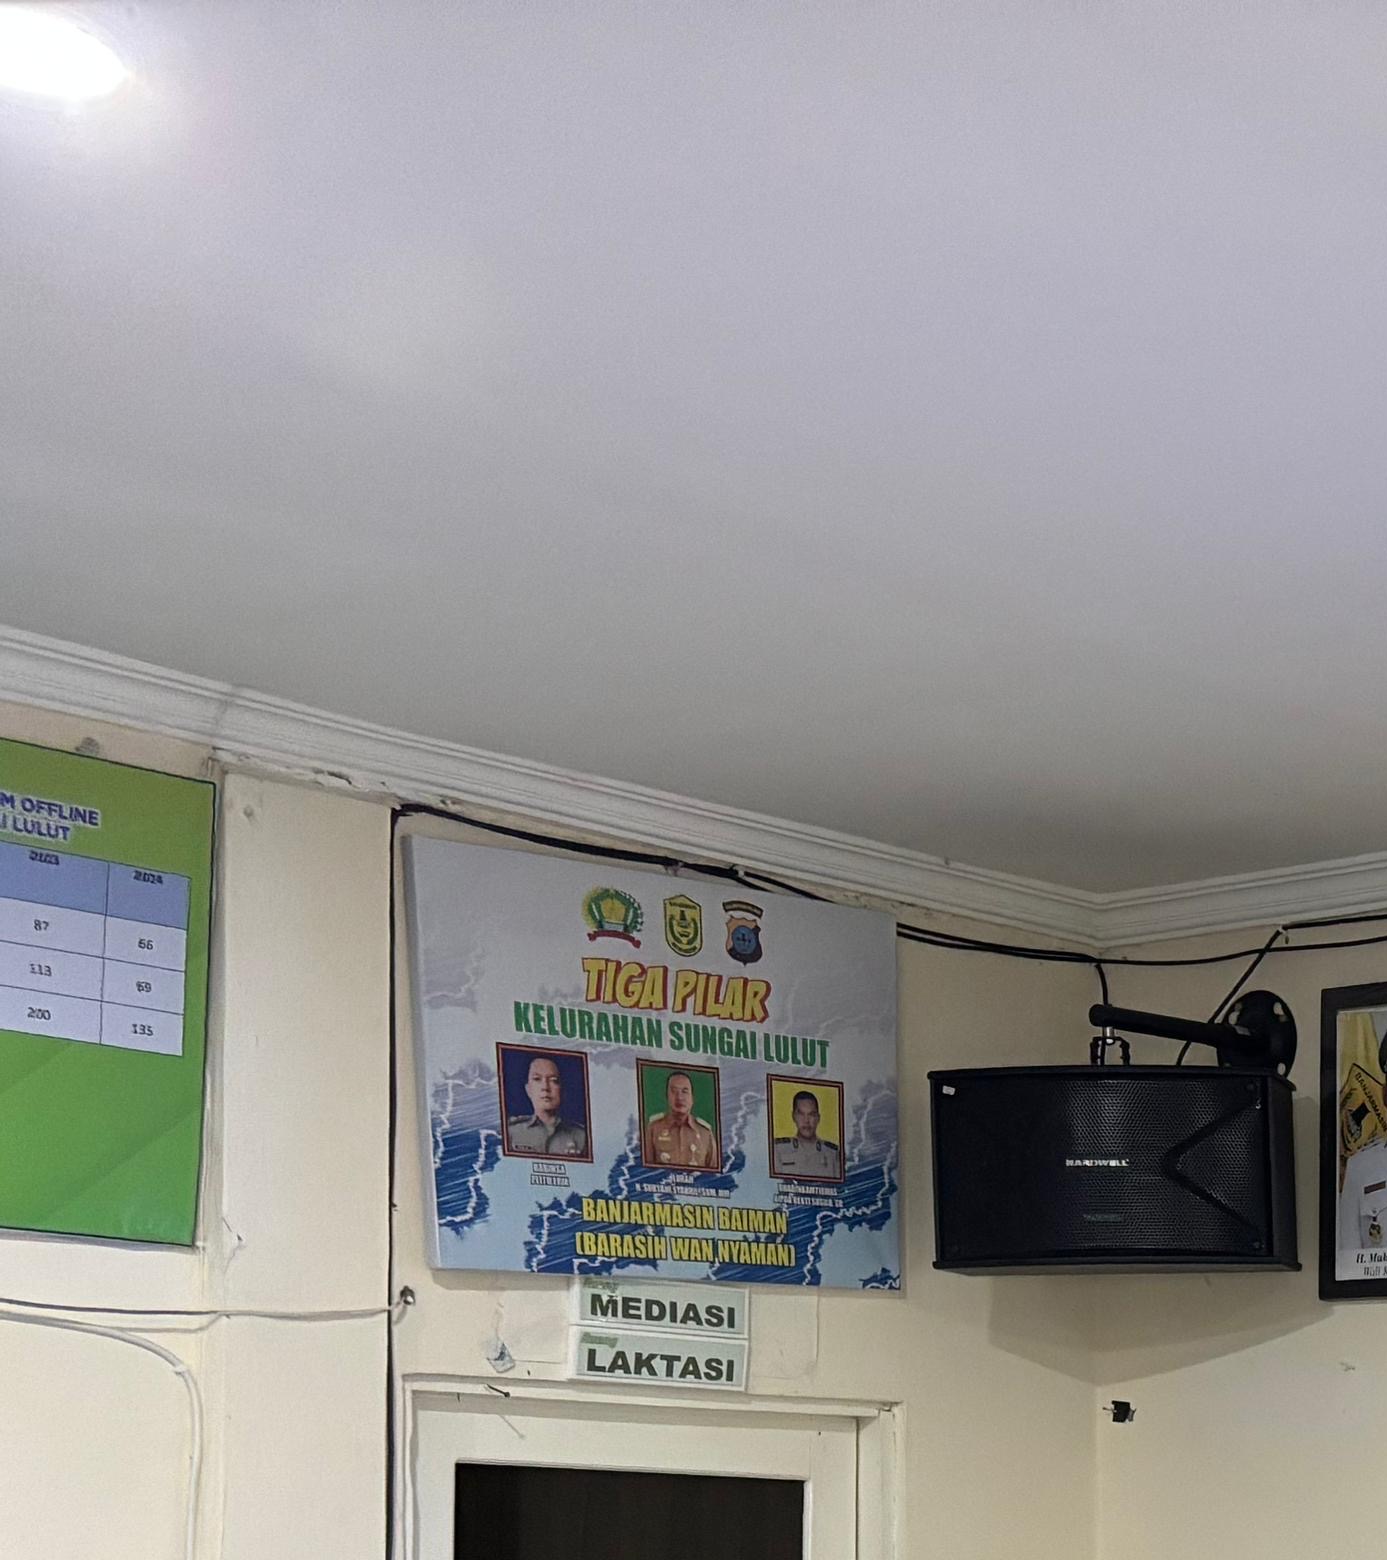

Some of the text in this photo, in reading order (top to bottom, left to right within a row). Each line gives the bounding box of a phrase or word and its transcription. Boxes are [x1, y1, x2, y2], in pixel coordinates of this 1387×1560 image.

[21, 797, 99, 826] OFFLINE
[13, 816, 70, 840] LULUT
[133, 870, 163, 885] 2024
[34, 920, 49, 931] 87
[582, 957, 772, 1023] TIGA PILAR
[131, 1023, 153, 1036] 135
[513, 1001, 830, 1068] KELURAHAN SUNGAI LULUT
[582, 1197, 787, 1235] BANJARMASIN BAIMAN
[575, 1230, 796, 1268] (BARASIH WAN NYAMAN)
[1356, 1254, 1366, 1264] H.
[590, 1293, 736, 1329] MEDIASI
[586, 1348, 735, 1383] LAKTASI
